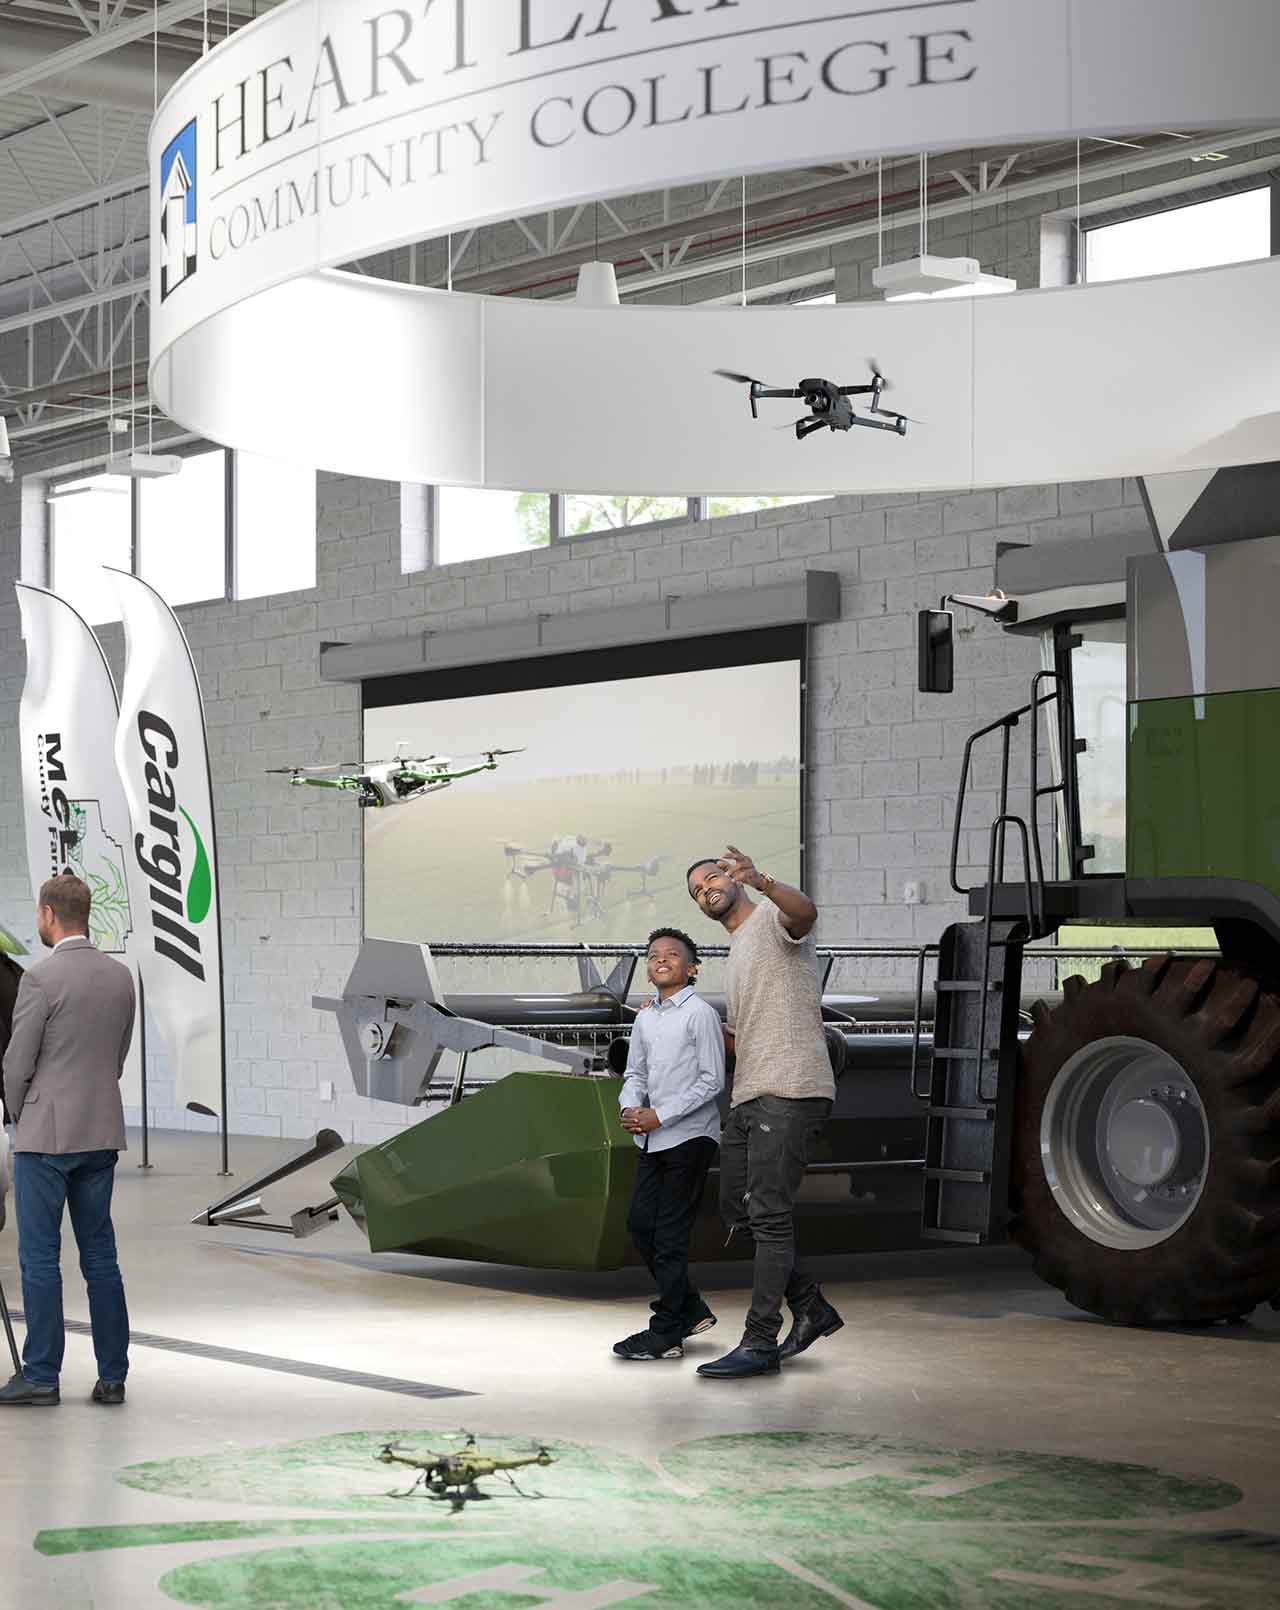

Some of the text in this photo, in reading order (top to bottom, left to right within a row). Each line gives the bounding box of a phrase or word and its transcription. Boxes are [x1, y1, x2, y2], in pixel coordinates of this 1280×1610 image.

[209, 29, 978, 260] COMMUNITY COLLEGE
[36, 733, 53, 818] County
[134, 710, 206, 982] Cargill
